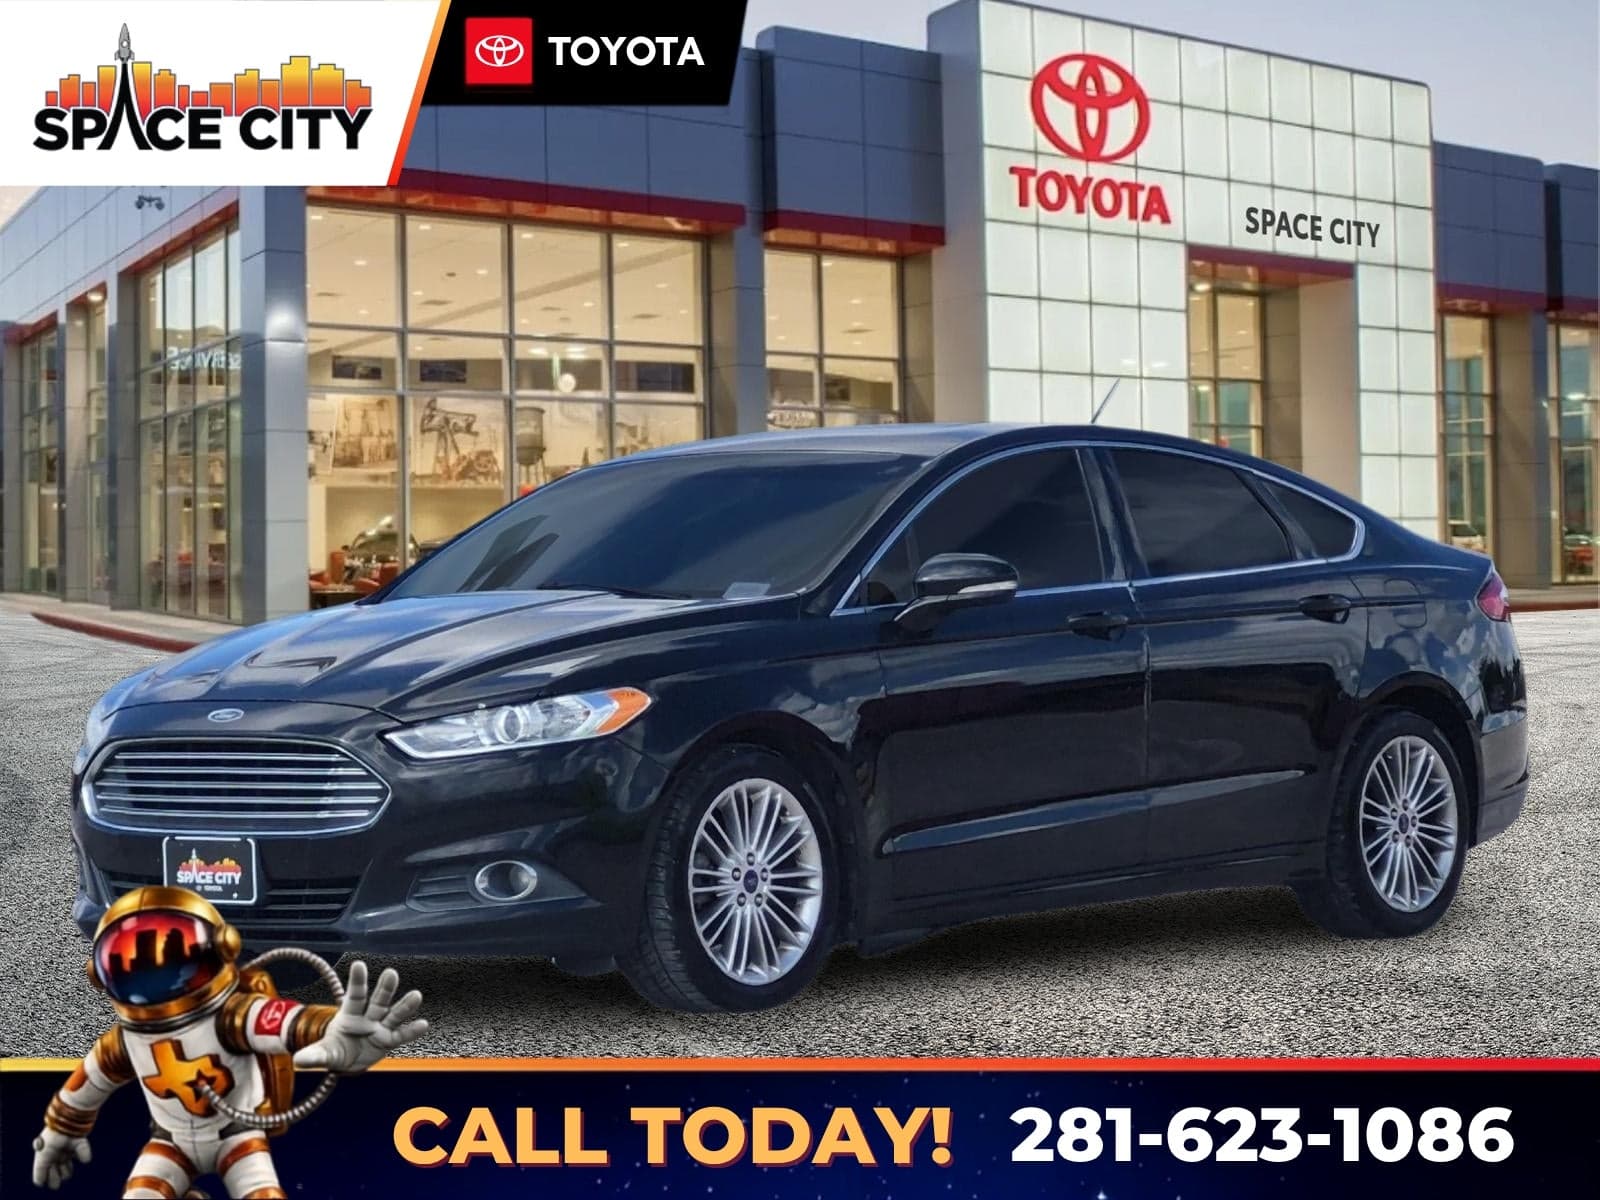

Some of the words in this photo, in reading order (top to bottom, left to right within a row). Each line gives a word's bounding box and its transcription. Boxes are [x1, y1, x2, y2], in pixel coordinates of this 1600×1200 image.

[1009, 166, 1171, 224] TOYOTA
[1245, 206, 1323, 241] SPACE
[1329, 218, 1380, 247] CITY
[177, 871, 213, 883] SPACE
[215, 871, 241, 884] CITY
